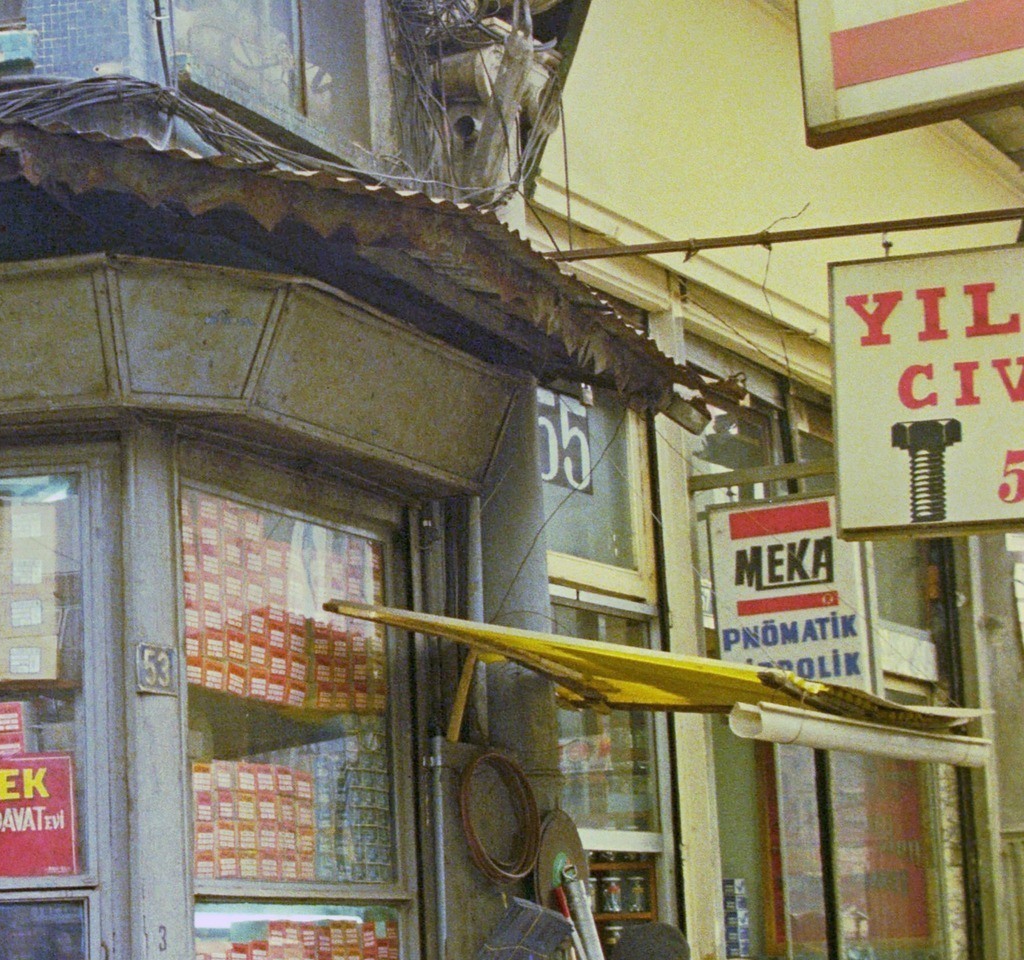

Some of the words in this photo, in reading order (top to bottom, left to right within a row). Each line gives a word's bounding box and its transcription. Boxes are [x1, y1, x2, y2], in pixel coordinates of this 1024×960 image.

[845, 282, 1021, 347] YIL
[735, 536, 834, 590] MEKA
[144, 649, 170, 687] 53
